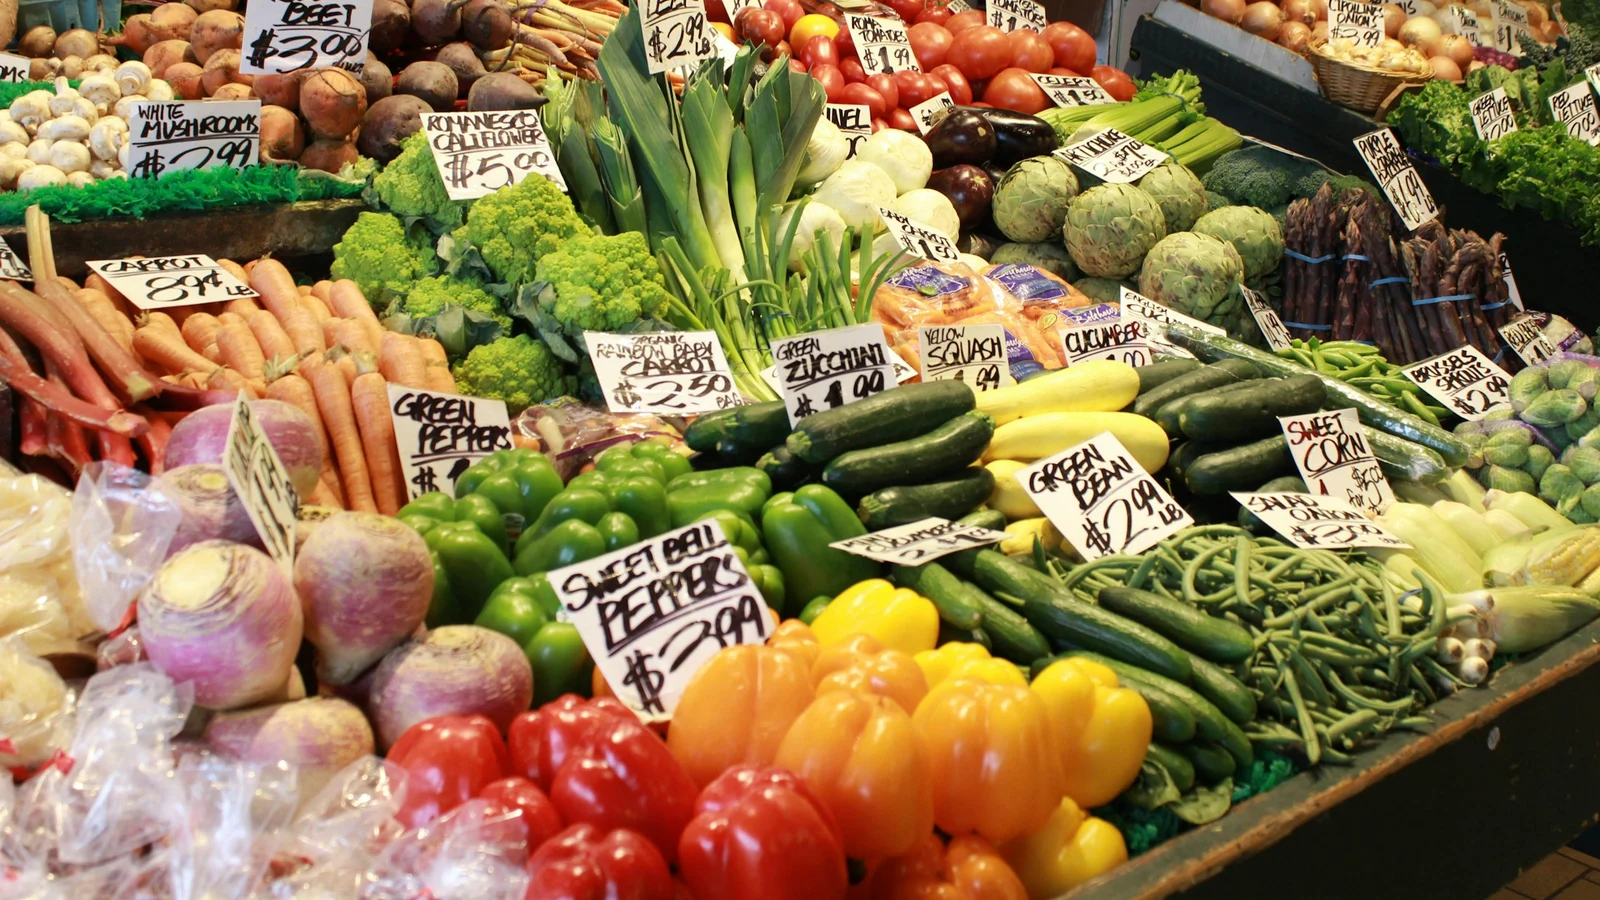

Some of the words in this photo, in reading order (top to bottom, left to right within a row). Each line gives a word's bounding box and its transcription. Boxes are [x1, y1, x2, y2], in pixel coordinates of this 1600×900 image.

[281, 2, 356, 27] BEET
[1337, 13, 1377, 28] ONIONS
[695, 37, 711, 56] LB
[858, 28, 907, 43] TOMATOES
[1037, 76, 1096, 88] CELERY
[138, 104, 185, 121] WHITE
[1472, 93, 1495, 117] GREEN
[1552, 91, 1569, 111] RED
[140, 113, 260, 140] MUSHROOMS
[427, 111, 539, 133] ROMANESCO
[1059, 128, 1127, 165] ARTICHOKE
[1358, 131, 1393, 163] PURPLE
[100, 256, 204, 273] CARROT
[226, 285, 255, 297] LB
[1124, 293, 1168, 312] ENGLISH
[632, 335, 686, 345] ORGANIC
[924, 327, 965, 346] YELLOW
[1065, 321, 1146, 354] CUCUMBER
[673, 341, 713, 360] BABY
[777, 338, 821, 361] GREEN
[927, 336, 1003, 368] SQUASH
[620, 356, 717, 377] CARROT
[1411, 350, 1477, 383] BRUSSELS
[1436, 362, 1491, 391] SPROUTS
[394, 392, 476, 425] GREEN
[418, 423, 512, 453] PEPPERS
[1287, 413, 1344, 446] SWEET
[1304, 432, 1366, 473] CORN
[1029, 443, 1105, 494] GREEN
[1072, 456, 1133, 511] BEAN
[1158, 503, 1183, 525] LB
[1248, 495, 1318, 513] SALAD
[1290, 508, 1364, 521] ONION
[562, 545, 660, 612] SWEET
[597, 554, 748, 651] PEPPERS
